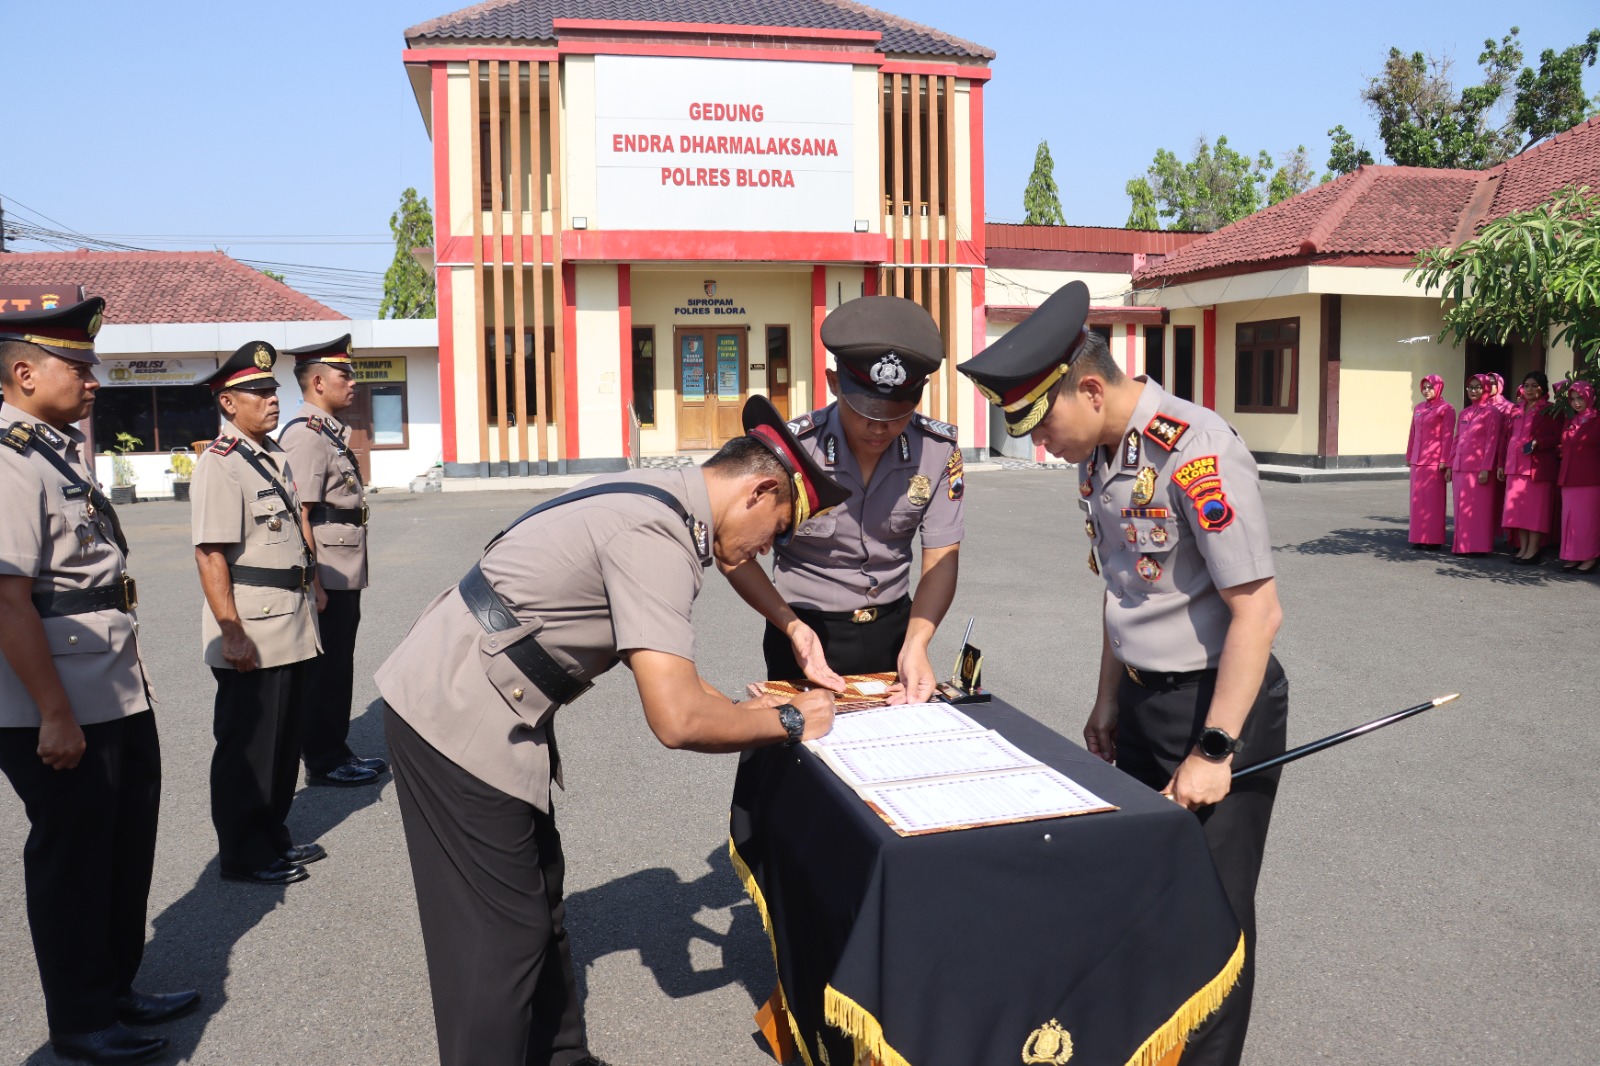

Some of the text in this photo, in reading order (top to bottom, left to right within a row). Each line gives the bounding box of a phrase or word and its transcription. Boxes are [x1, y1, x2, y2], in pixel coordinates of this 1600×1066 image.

[689, 102, 764, 122] GEDUNG
[612, 134, 838, 156] ENDRA DHARMALAKSANA
[661, 167, 795, 188] POLRES BLORA
[687, 298, 733, 306] SIPROPAM
[674, 307, 746, 315] POLRES BLORA
[128, 360, 164, 369] POLISI
[359, 361, 393, 369] PAMAPTA
[365, 370, 389, 379] BLORA
[1175, 457, 1215, 480] POLRES
[1180, 465, 1215, 486] BLORA
